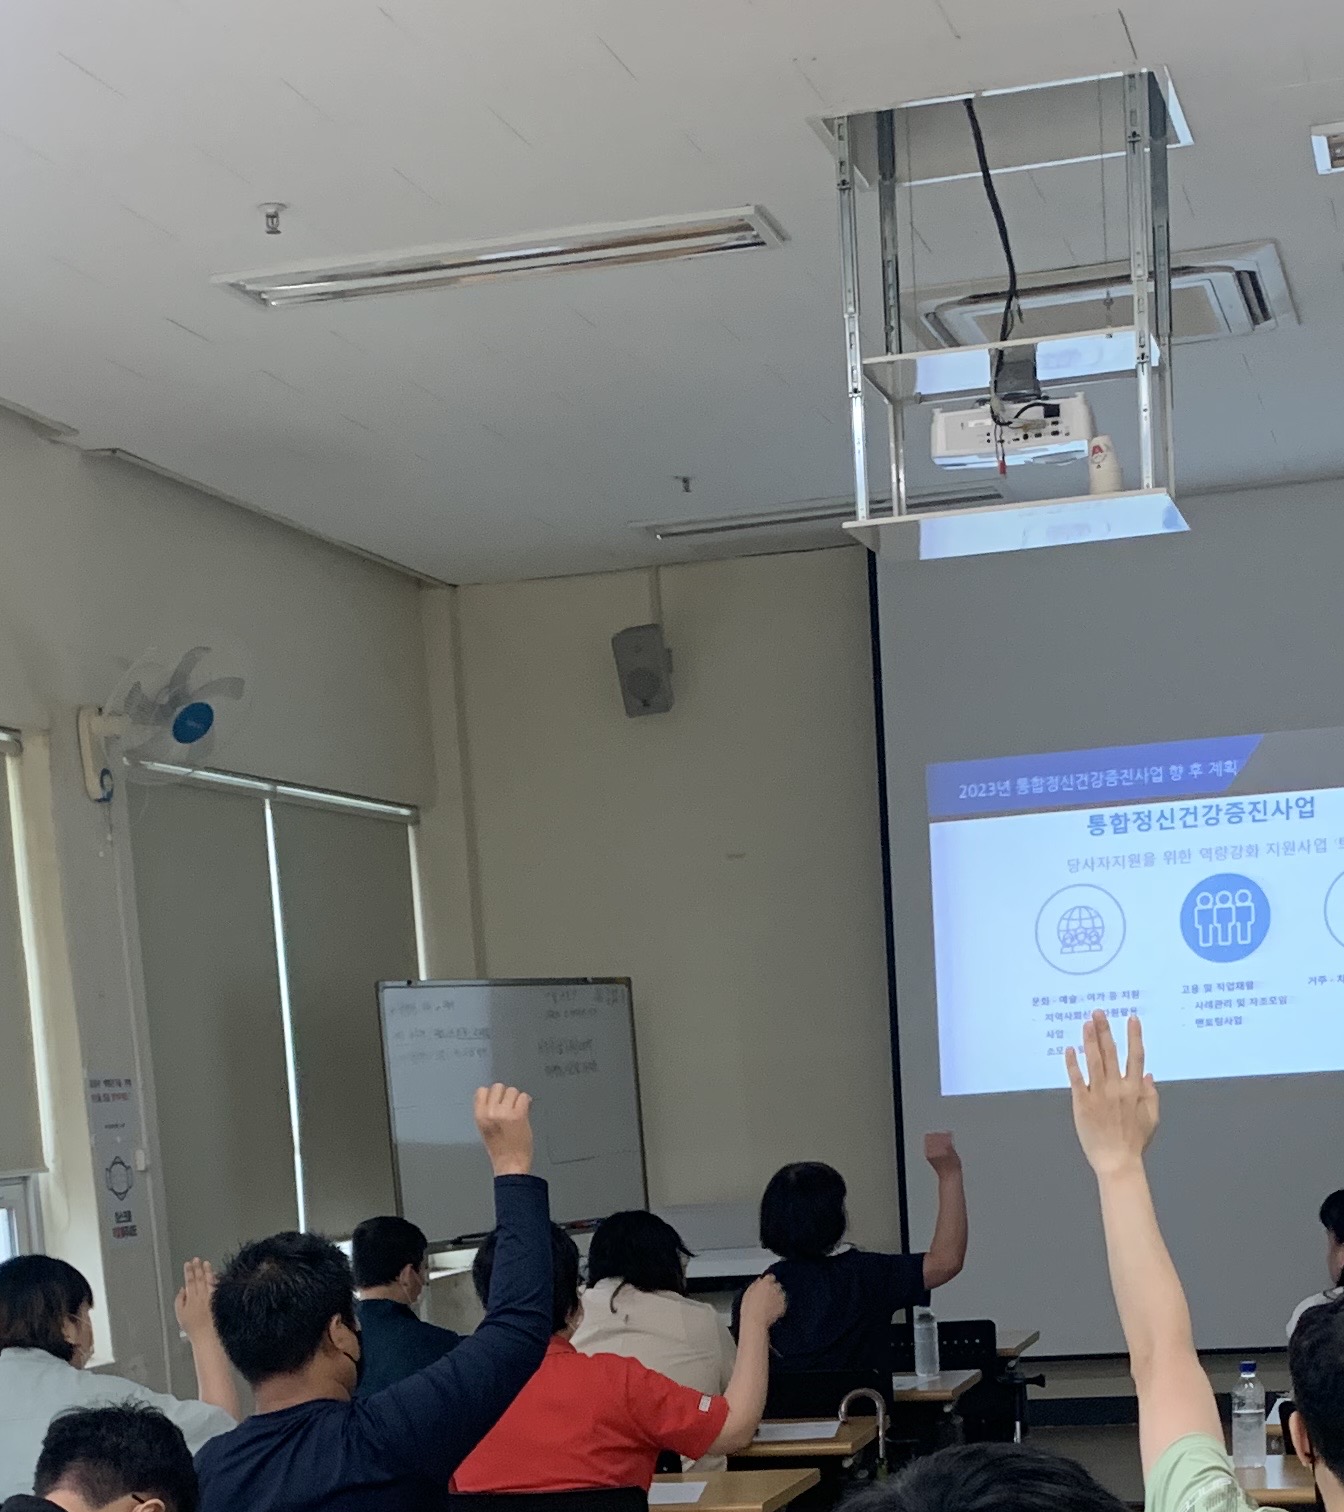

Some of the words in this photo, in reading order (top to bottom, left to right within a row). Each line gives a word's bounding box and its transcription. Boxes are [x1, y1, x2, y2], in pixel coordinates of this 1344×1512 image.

[959, 779, 1011, 798] 2023년
[1016, 766, 1163, 795] 통합정신건강증진사업
[1189, 762, 1203, 779] 후
[1208, 760, 1238, 777] 계획
[1087, 796, 1316, 836] 통합정신건강증진사업
[1067, 852, 1156, 873] 당사자지원을
[1163, 848, 1191, 865] 위한
[1199, 843, 1259, 861] 역량강화
[1266, 837, 1327, 856] 지원사업
